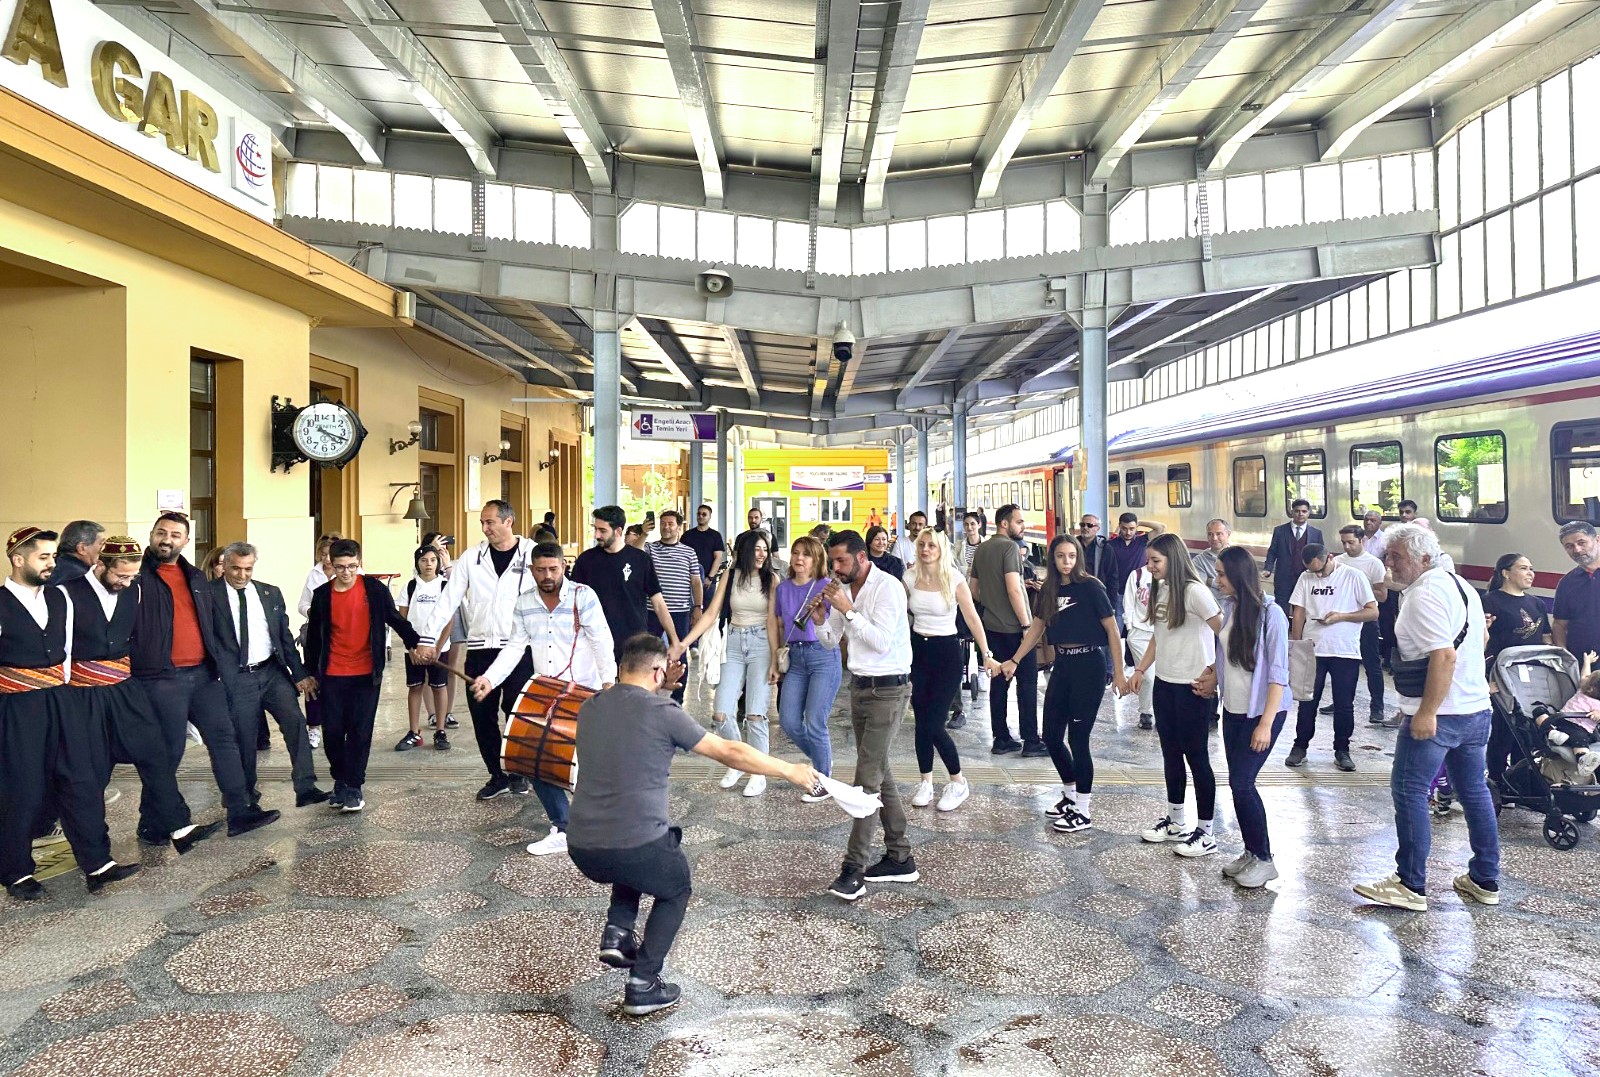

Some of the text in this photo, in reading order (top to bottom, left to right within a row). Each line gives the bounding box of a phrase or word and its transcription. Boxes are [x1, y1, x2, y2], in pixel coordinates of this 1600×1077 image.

[91, 40, 221, 173] GAR
[307, 419, 315, 427] 10
[338, 420, 344, 428] 2
[303, 427, 309, 435] 9
[340, 428, 346, 436] 3
[307, 436, 312, 444] 8
[313, 441, 319, 449] 7
[321, 444, 328, 452] 6
[1311, 586, 1335, 595] levi's
[1066, 647, 1090, 655] NIKE
